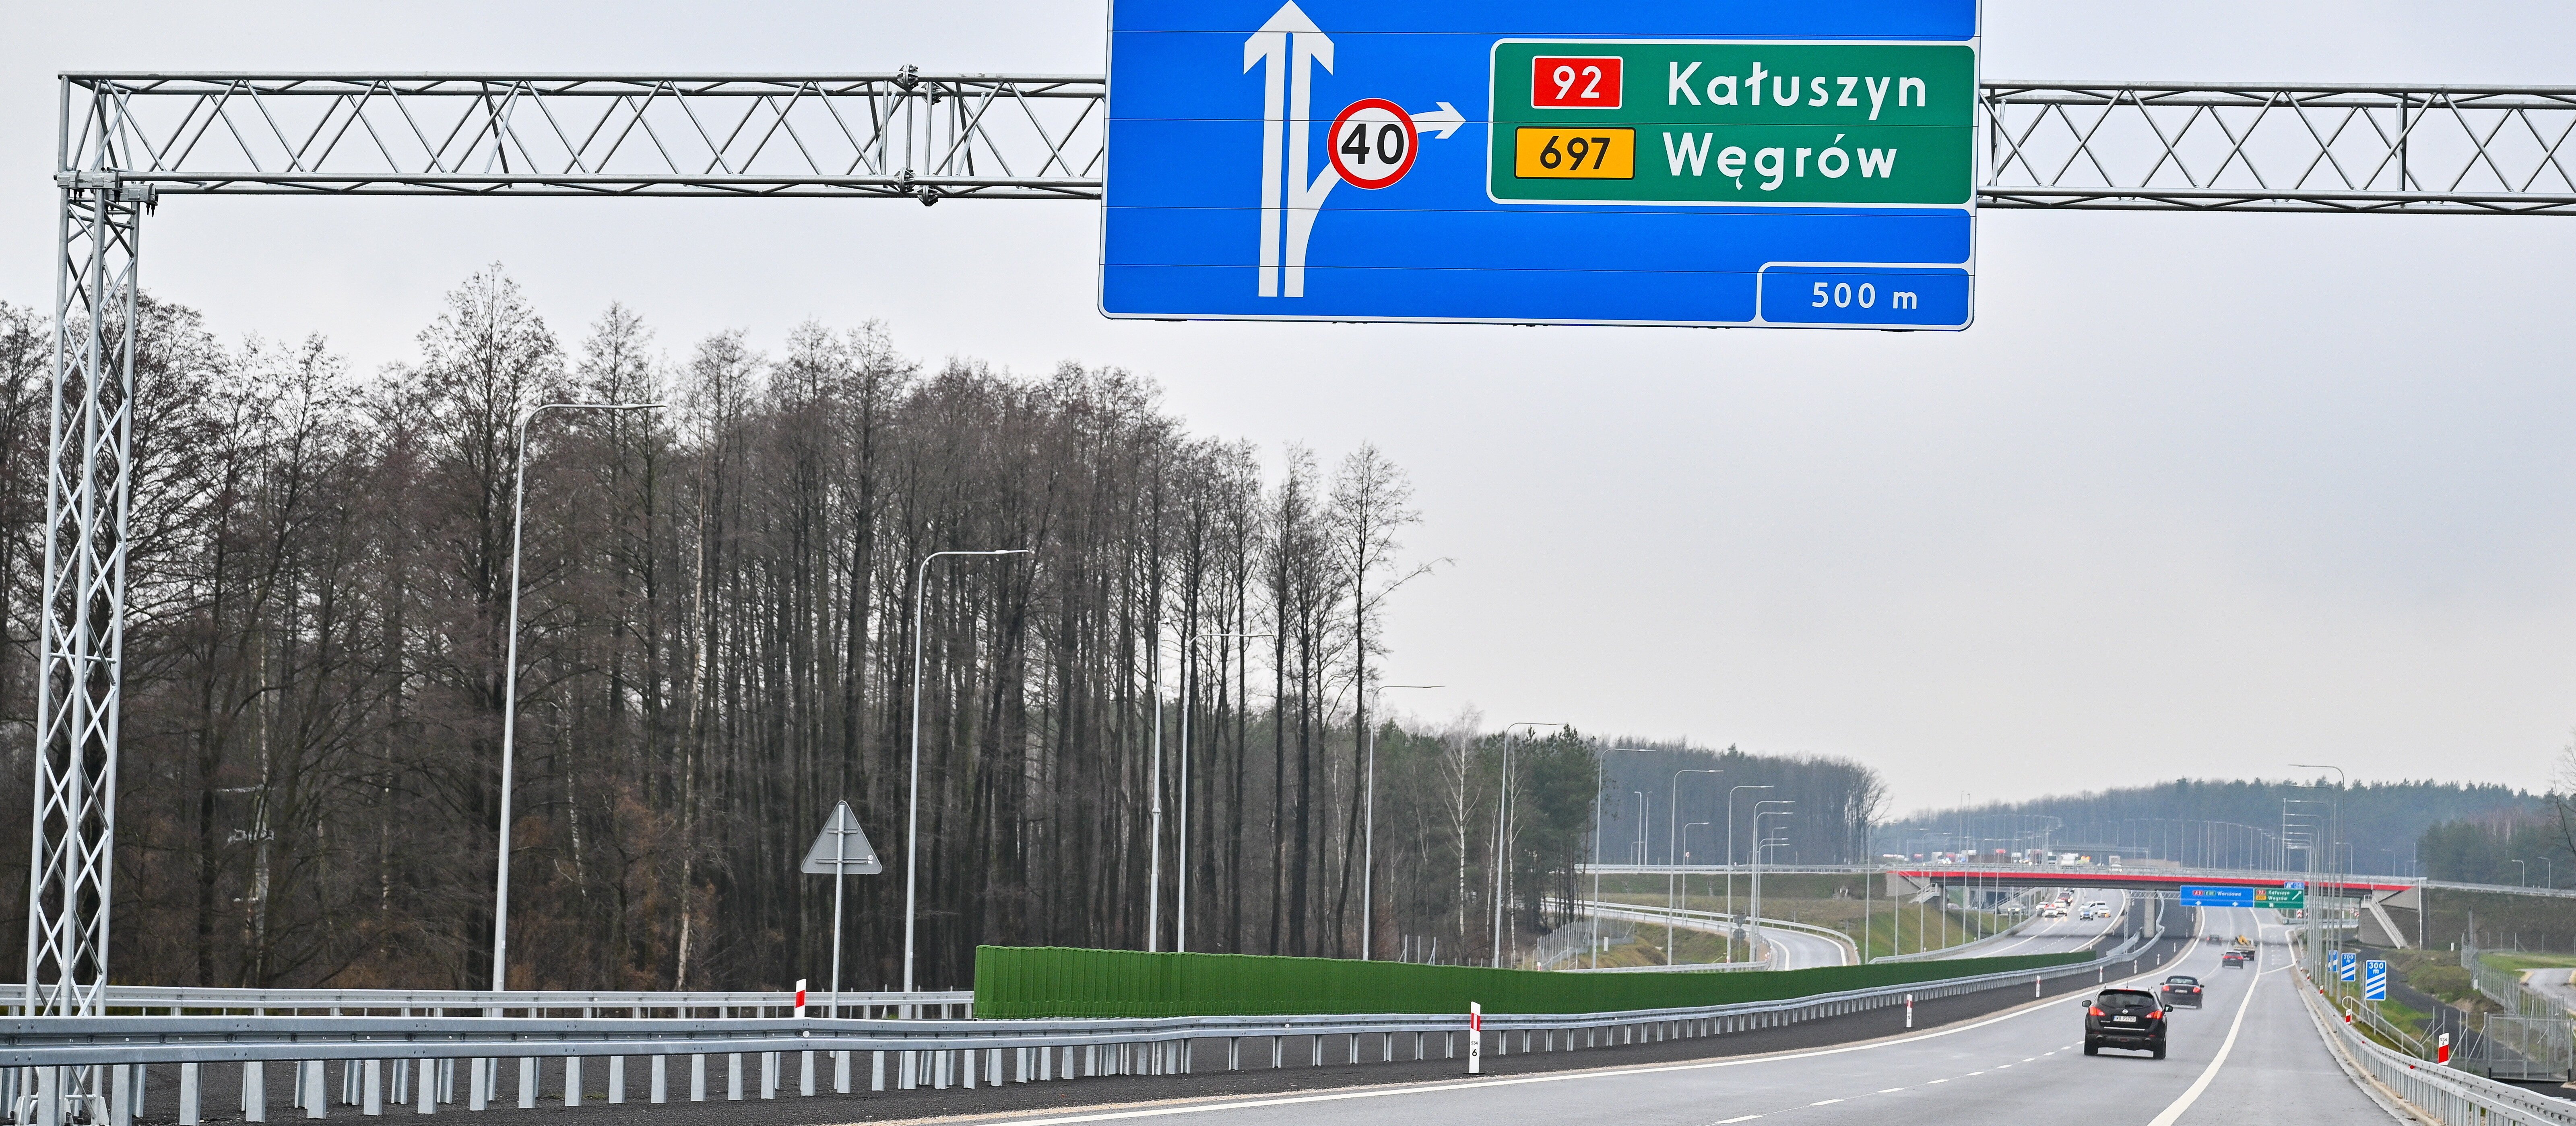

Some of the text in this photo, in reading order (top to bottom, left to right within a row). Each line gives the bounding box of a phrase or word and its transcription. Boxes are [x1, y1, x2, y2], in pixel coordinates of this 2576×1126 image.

[1553, 62, 1926, 121] 92 Kałuszyn
[1341, 123, 1404, 165] 40
[1540, 132, 1897, 191] 697 Węgrów
[1812, 282, 1917, 309] 500 m
[1472, 1048, 1477, 1057] 6
